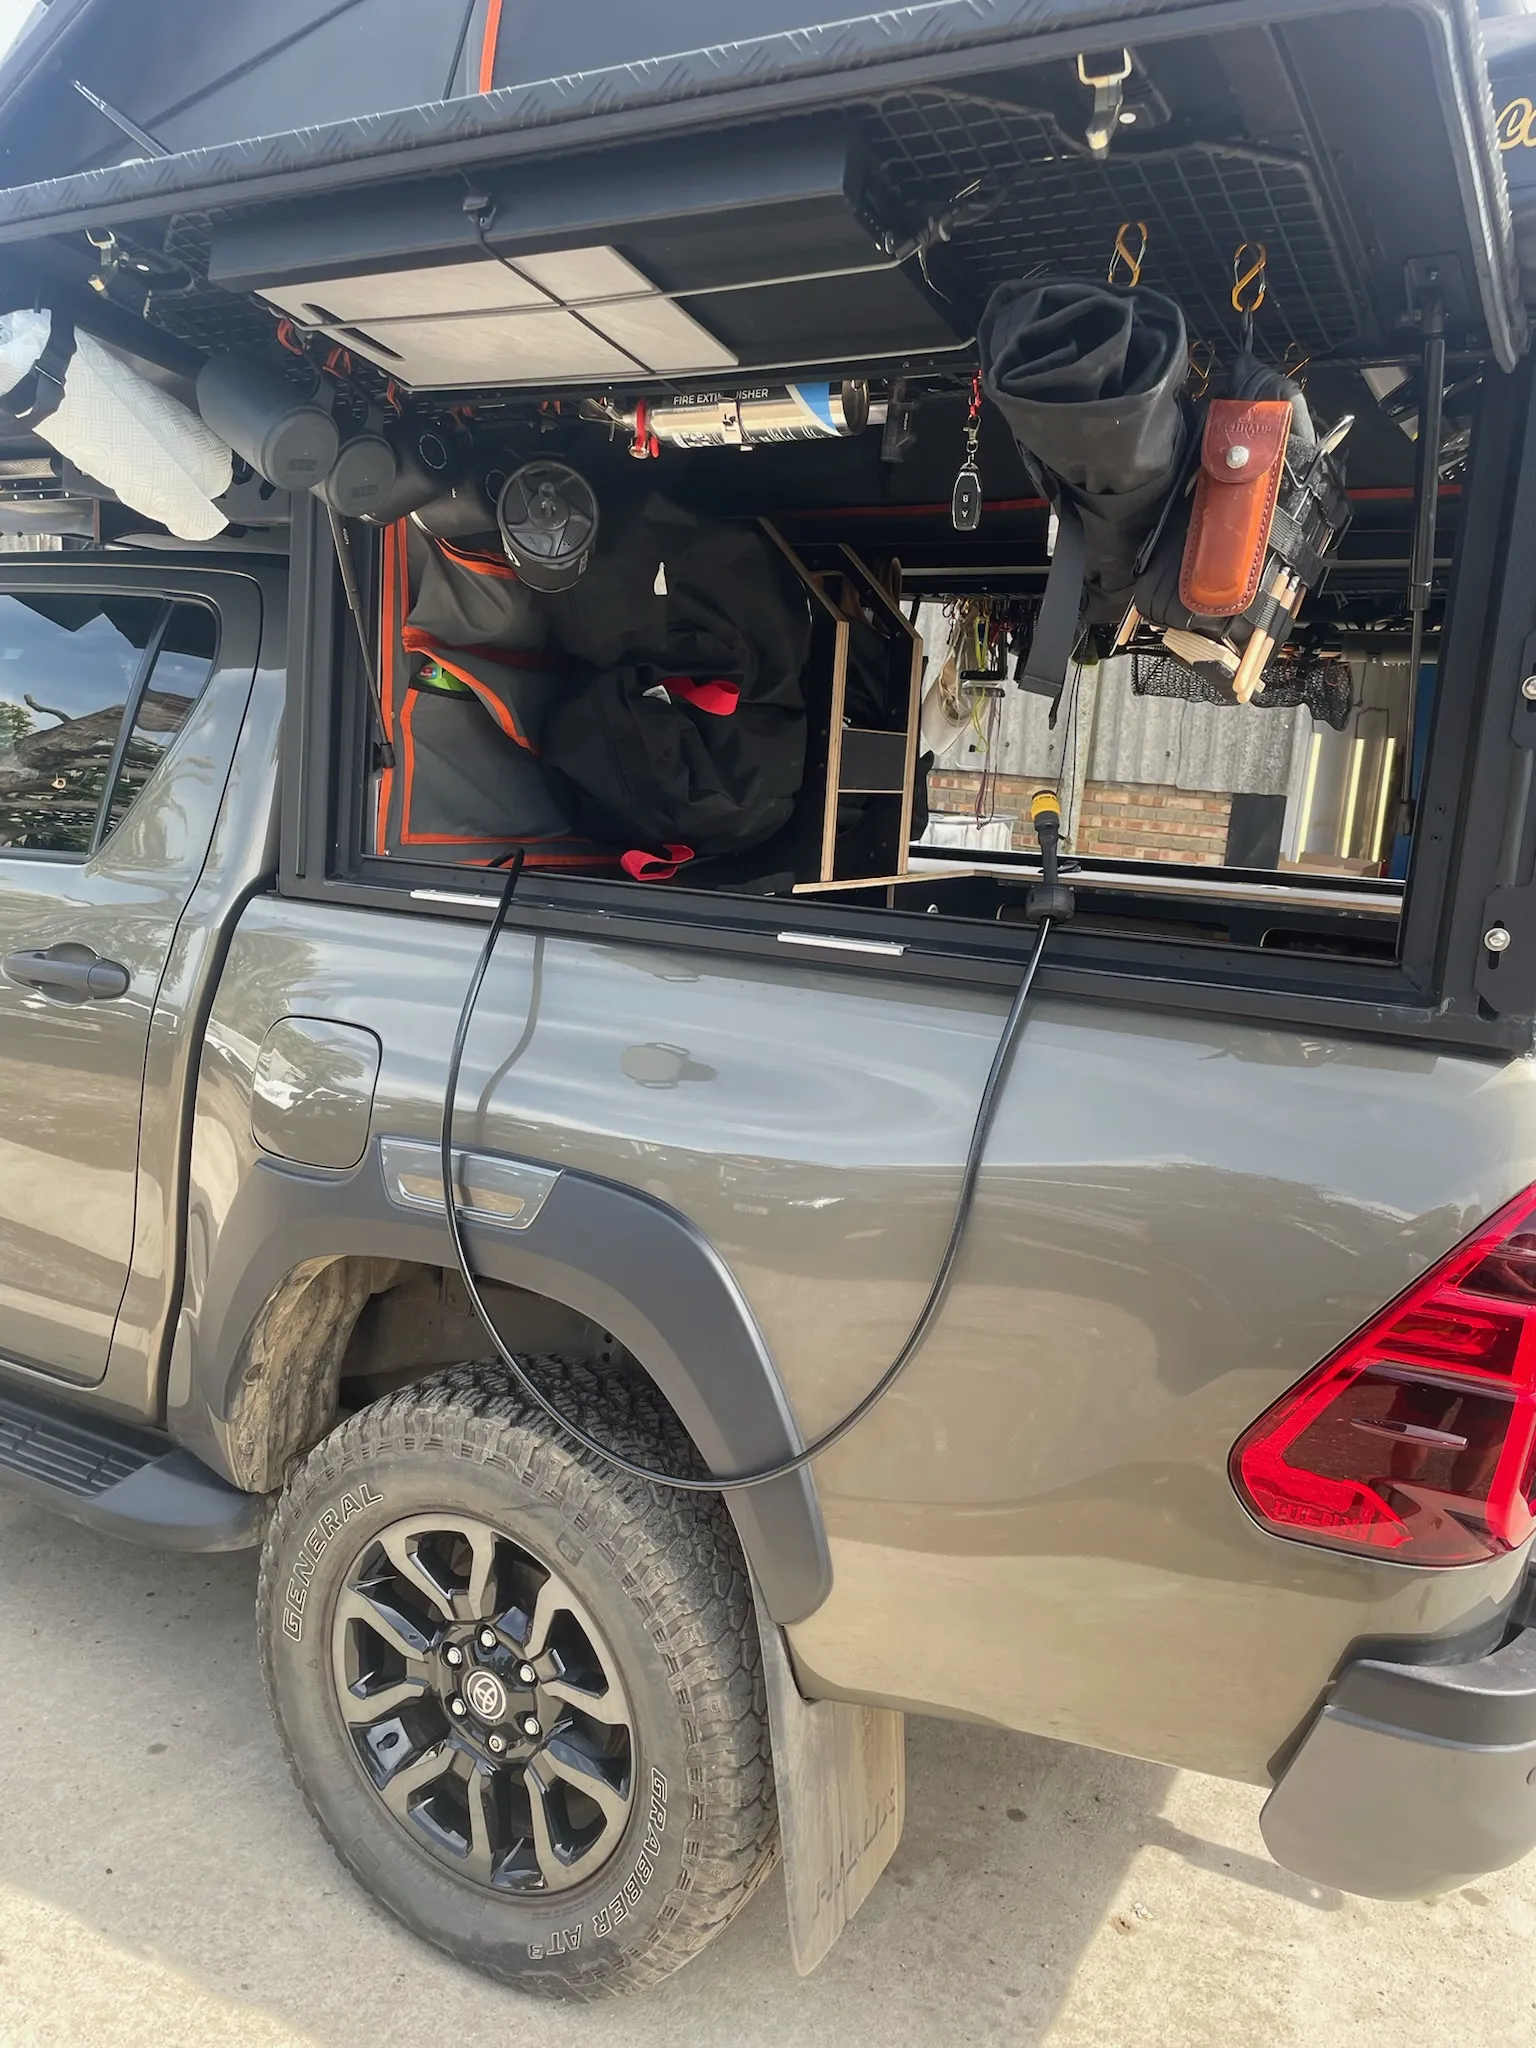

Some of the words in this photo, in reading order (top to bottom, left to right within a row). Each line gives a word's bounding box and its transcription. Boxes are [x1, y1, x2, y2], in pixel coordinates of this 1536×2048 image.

[673, 393, 696, 406] FIRE
[282, 1483, 385, 1642] GENERAL
[591, 1766, 668, 1938] GRABBER
